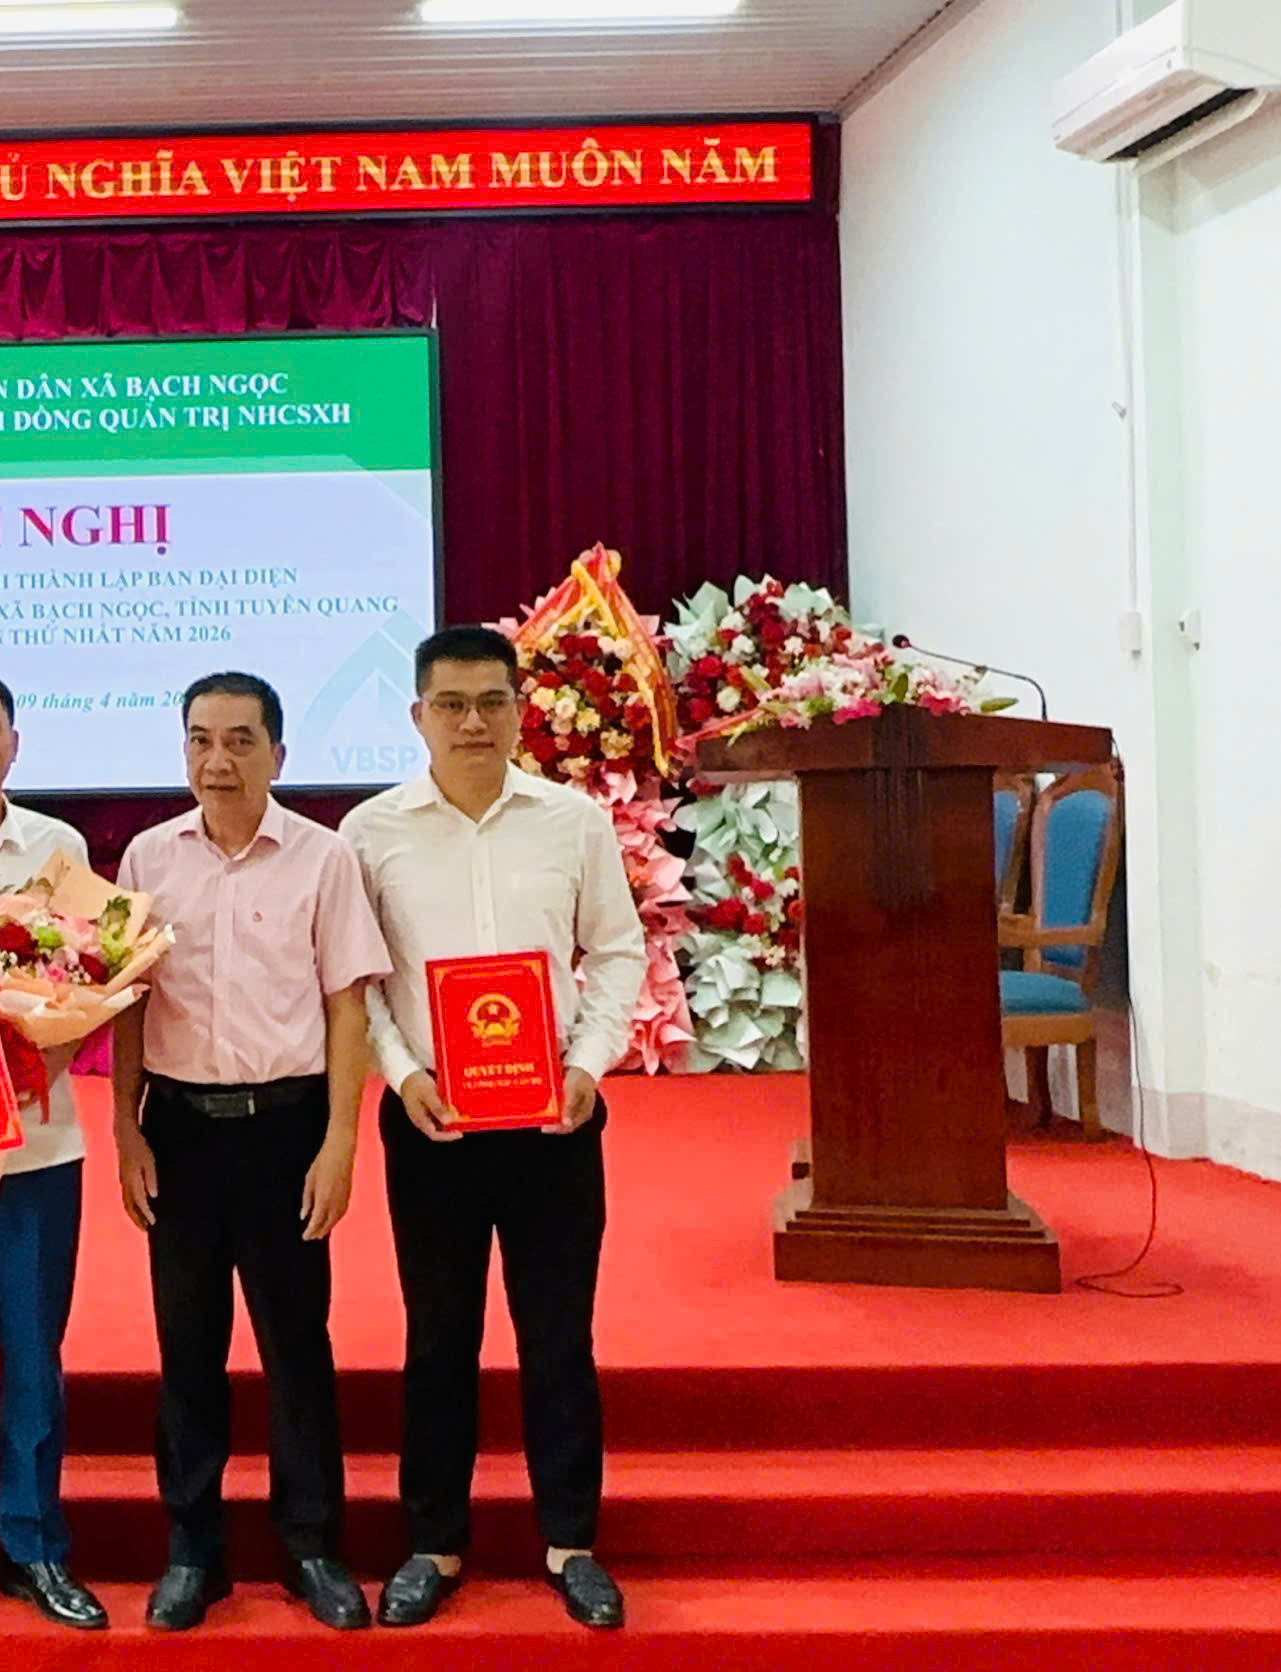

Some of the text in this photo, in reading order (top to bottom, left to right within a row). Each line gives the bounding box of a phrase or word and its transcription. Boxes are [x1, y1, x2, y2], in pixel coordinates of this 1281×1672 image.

[45, 149, 211, 199] NGHĨA
[221, 150, 342, 203] VIỆT
[356, 153, 475, 192] NAM
[489, 137, 644, 188] MUÔN
[659, 136, 779, 184] NĂM
[17, 373, 72, 400] DÂN
[81, 372, 118, 398] XÃ
[126, 375, 201, 402] BẠCH
[209, 373, 288, 399] NGỌC
[99, 402, 176, 433] QUẢN
[183, 406, 229, 431] TRỊ
[239, 404, 351, 426] NHCSXH
[20, 503, 171, 555] NGHỊ
[16, 568, 93, 589] THÀNH
[101, 568, 144, 592] LẬP
[149, 570, 193, 586] BAN
[245, 567, 297, 588] DIỆN
[32, 602, 93, 623] BẠCH
[100, 600, 170, 621] NGỌC,
[176, 596, 229, 617] TỈNH
[236, 594, 311, 616] TUYÊN
[318, 595, 399, 617] QUANG
[10, 624, 58, 645] THỨ
[64, 622, 126, 643] NHẤT
[131, 623, 182, 641] NĂM
[188, 625, 231, 641] 2026
[16, 693, 37, 709] 09
[43, 693, 93, 712] tháng
[99, 691, 111, 708] 4
[116, 691, 155, 707] năm
[330, 745, 420, 773] VBSP
